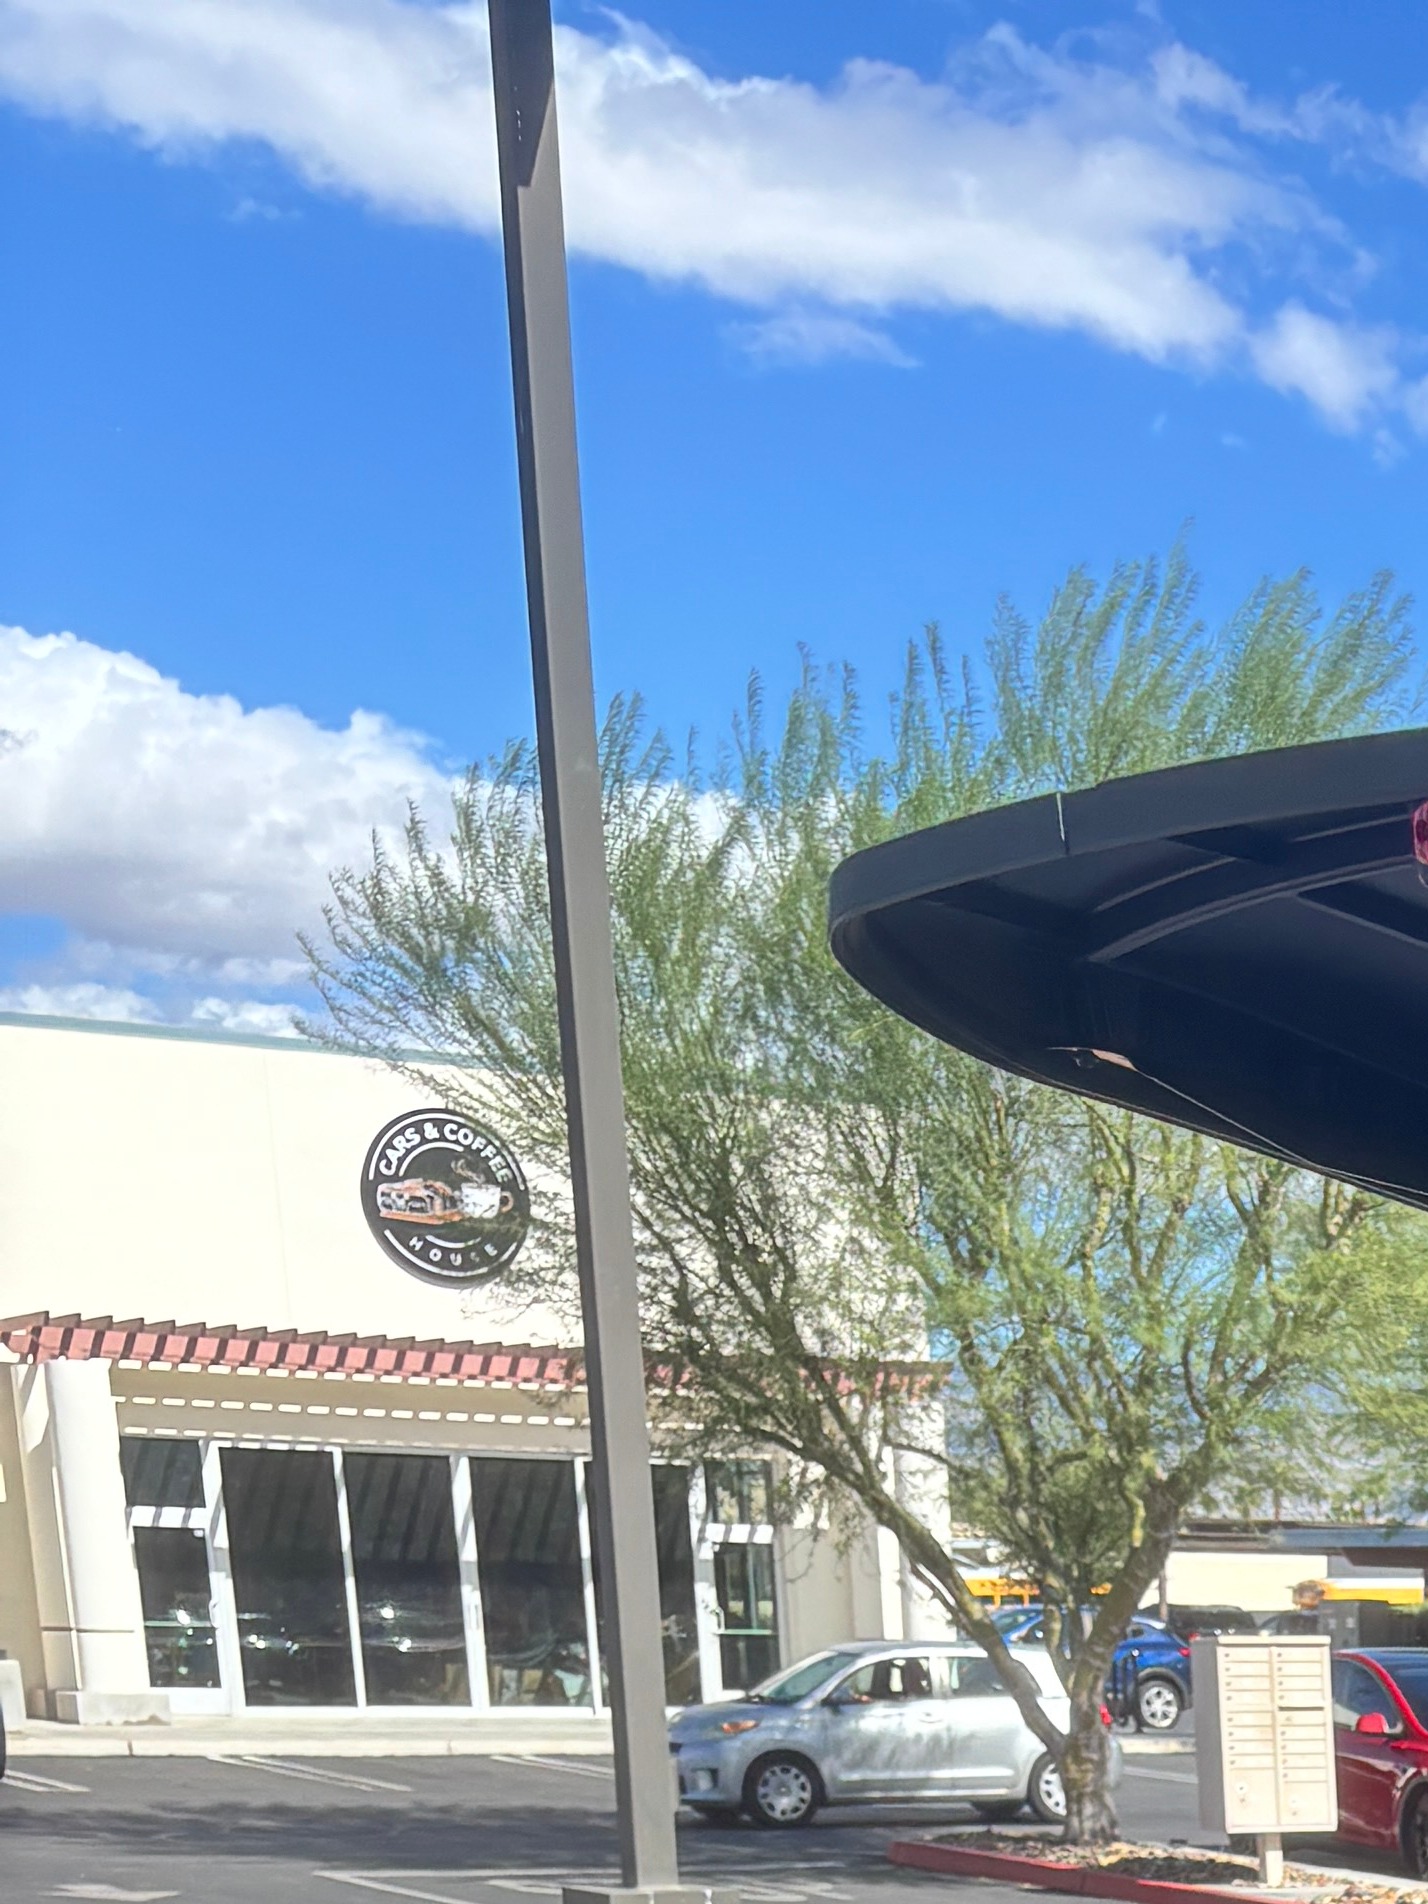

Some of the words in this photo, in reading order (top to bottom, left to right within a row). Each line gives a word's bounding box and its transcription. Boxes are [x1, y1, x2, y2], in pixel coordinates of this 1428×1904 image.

[379, 1127, 421, 1176] CARS
[423, 1122, 440, 1139] &
[443, 1123, 513, 1183] COFFEE
[408, 1236, 498, 1266] HOUSE
